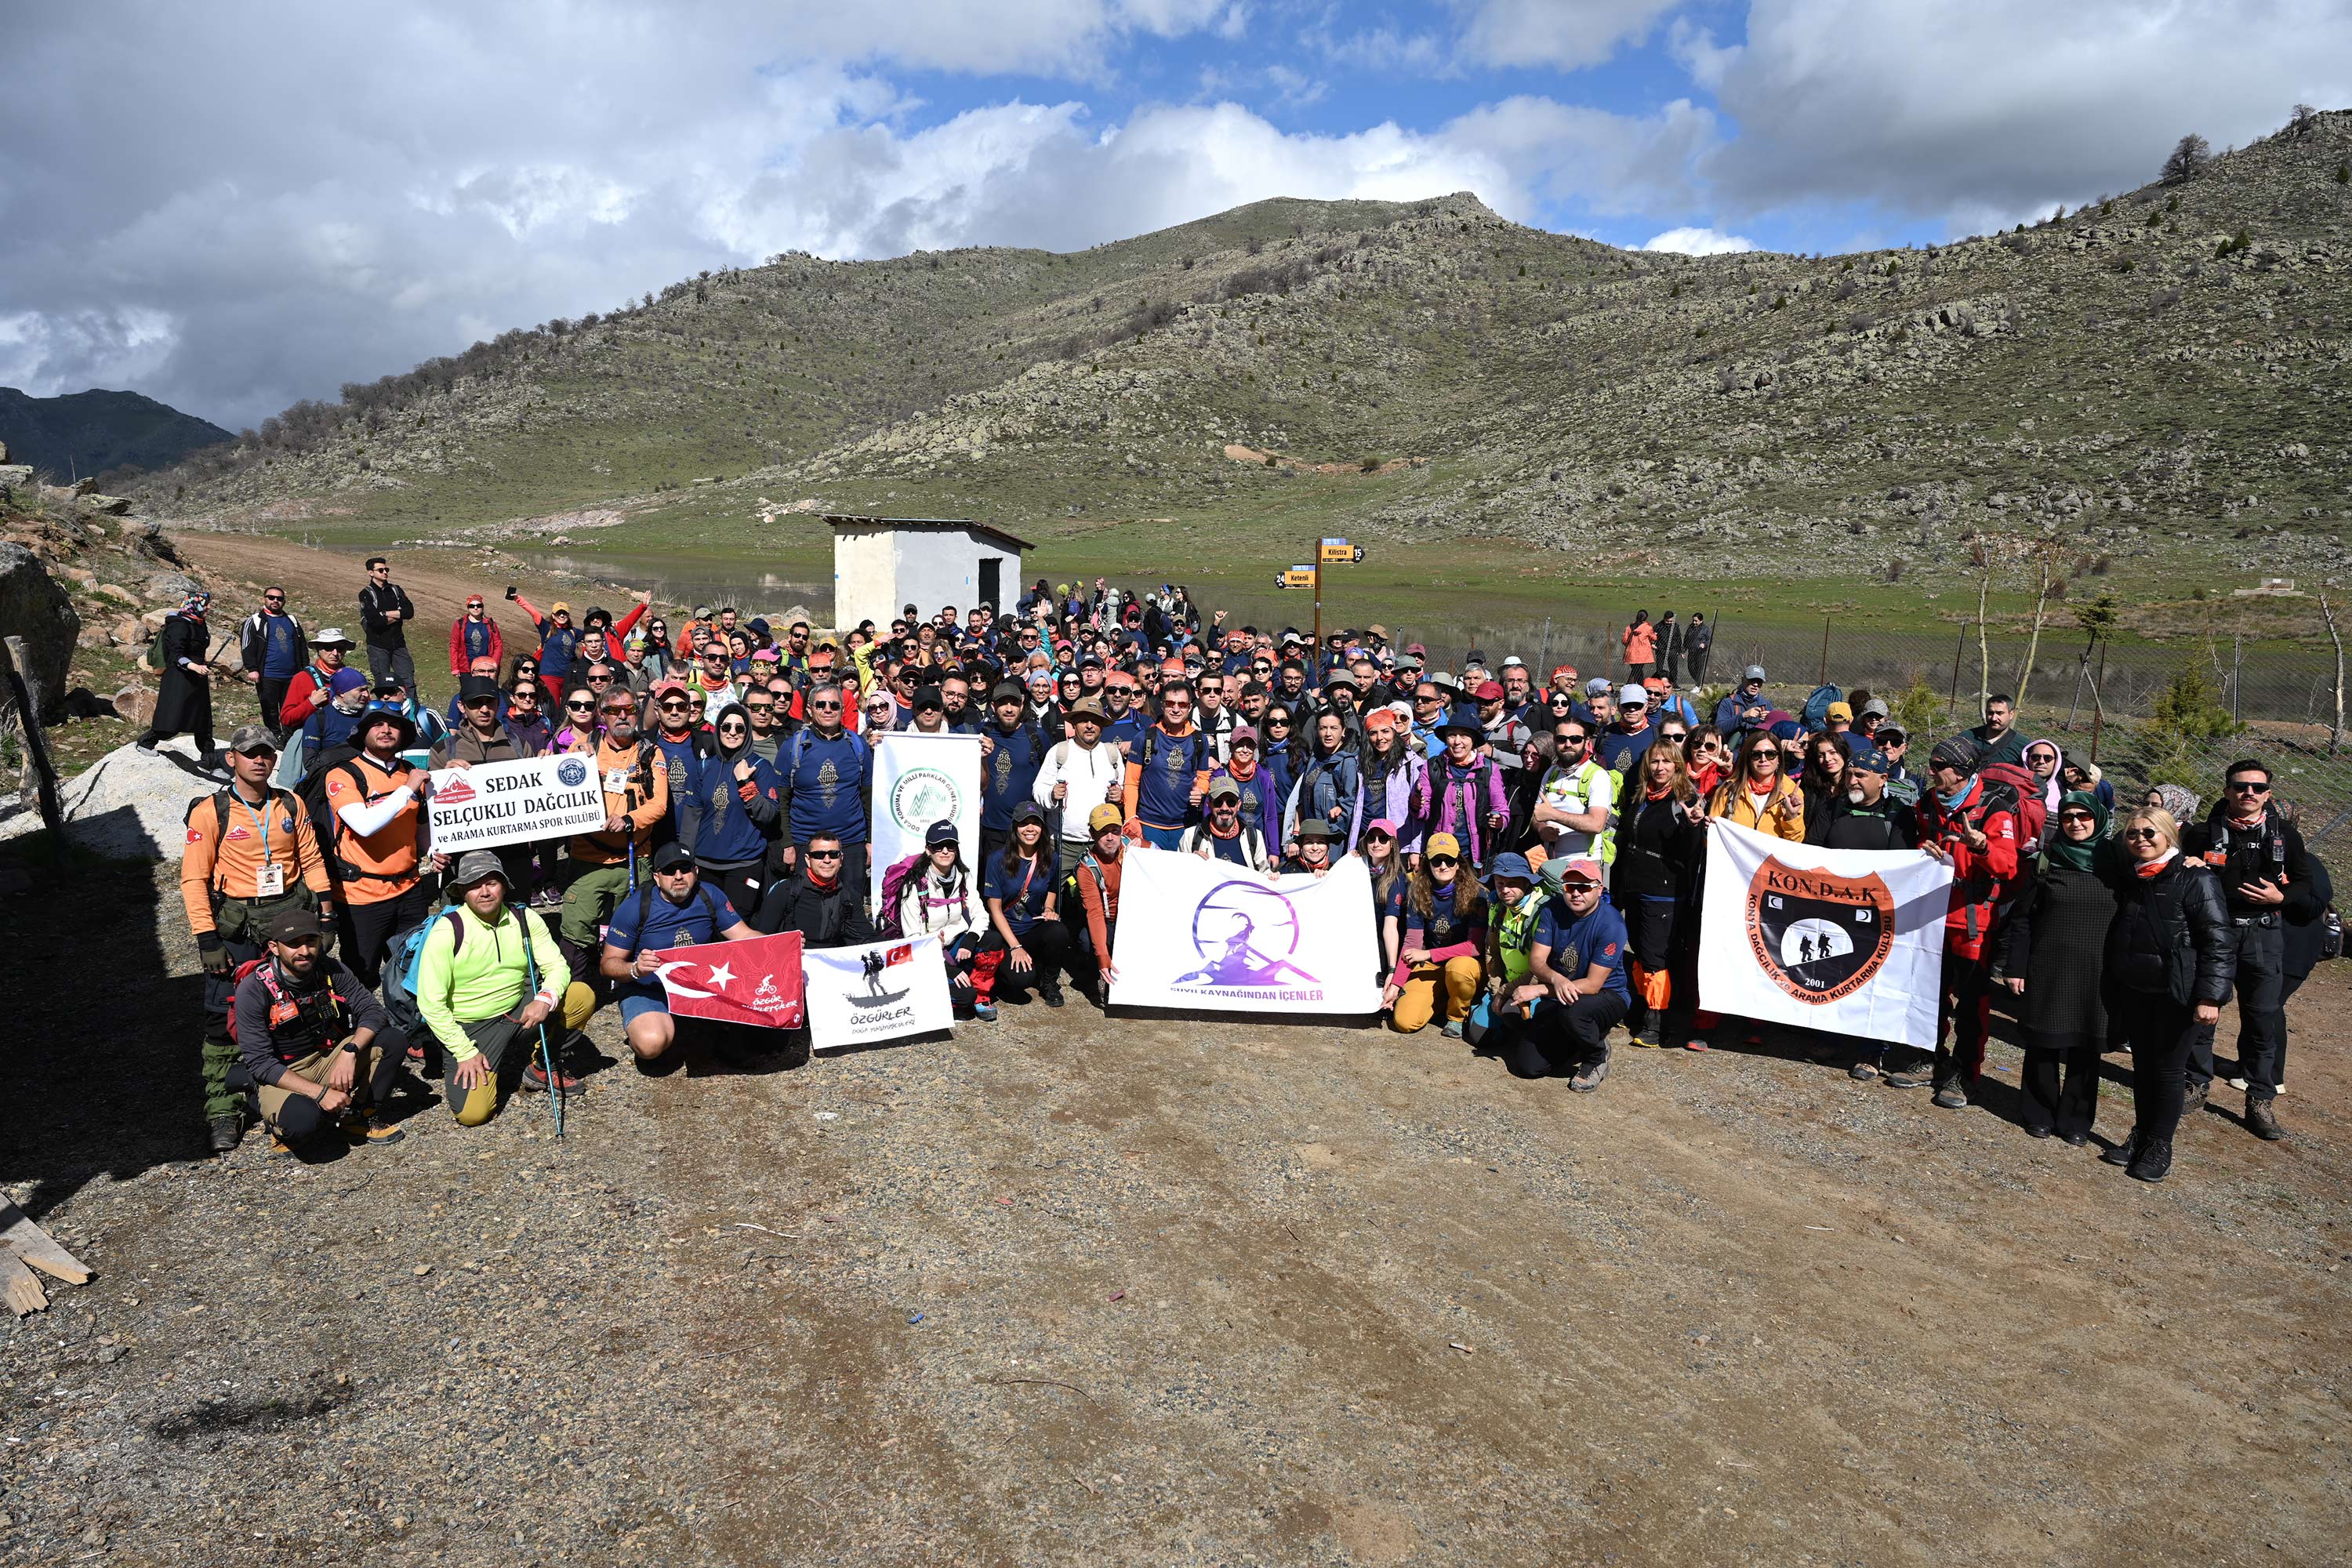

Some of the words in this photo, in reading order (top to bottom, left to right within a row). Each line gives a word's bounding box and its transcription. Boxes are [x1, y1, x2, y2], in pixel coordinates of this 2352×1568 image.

[1354, 549, 1362, 557] 15
[1276, 575, 1284, 583] 24
[485, 771, 543, 793] SEDAK
[918, 772, 946, 785] PARKLAR
[897, 784, 905, 793] VE
[945, 783, 956, 802] GENEL
[434, 801, 517, 827] SELÇUKLU
[524, 789, 599, 815] DAĞCILIK
[895, 793, 905, 820] KORUMA
[437, 835, 448, 844] ve
[450, 829, 485, 842] ARAMA
[487, 820, 539, 837] KURTARMA
[539, 817, 563, 829] SPOR
[564, 811, 601, 826] KULÜBÜ
[1767, 870, 1879, 902] KON.D.A.K
[1747, 893, 1758, 931] KONYA
[1750, 933, 1781, 981] DAĞCILIK
[1780, 979, 1791, 990] ve
[1804, 978, 1825, 989] 2001
[1829, 960, 1880, 1000] KURTARMA
[1200, 989, 1277, 1000] KAYNAĞINDAN
[1279, 989, 1324, 1002] İÇENLER
[1791, 988, 1828, 1004] ARAMA
[851, 1007, 916, 1025] ÖZGÜRLER
